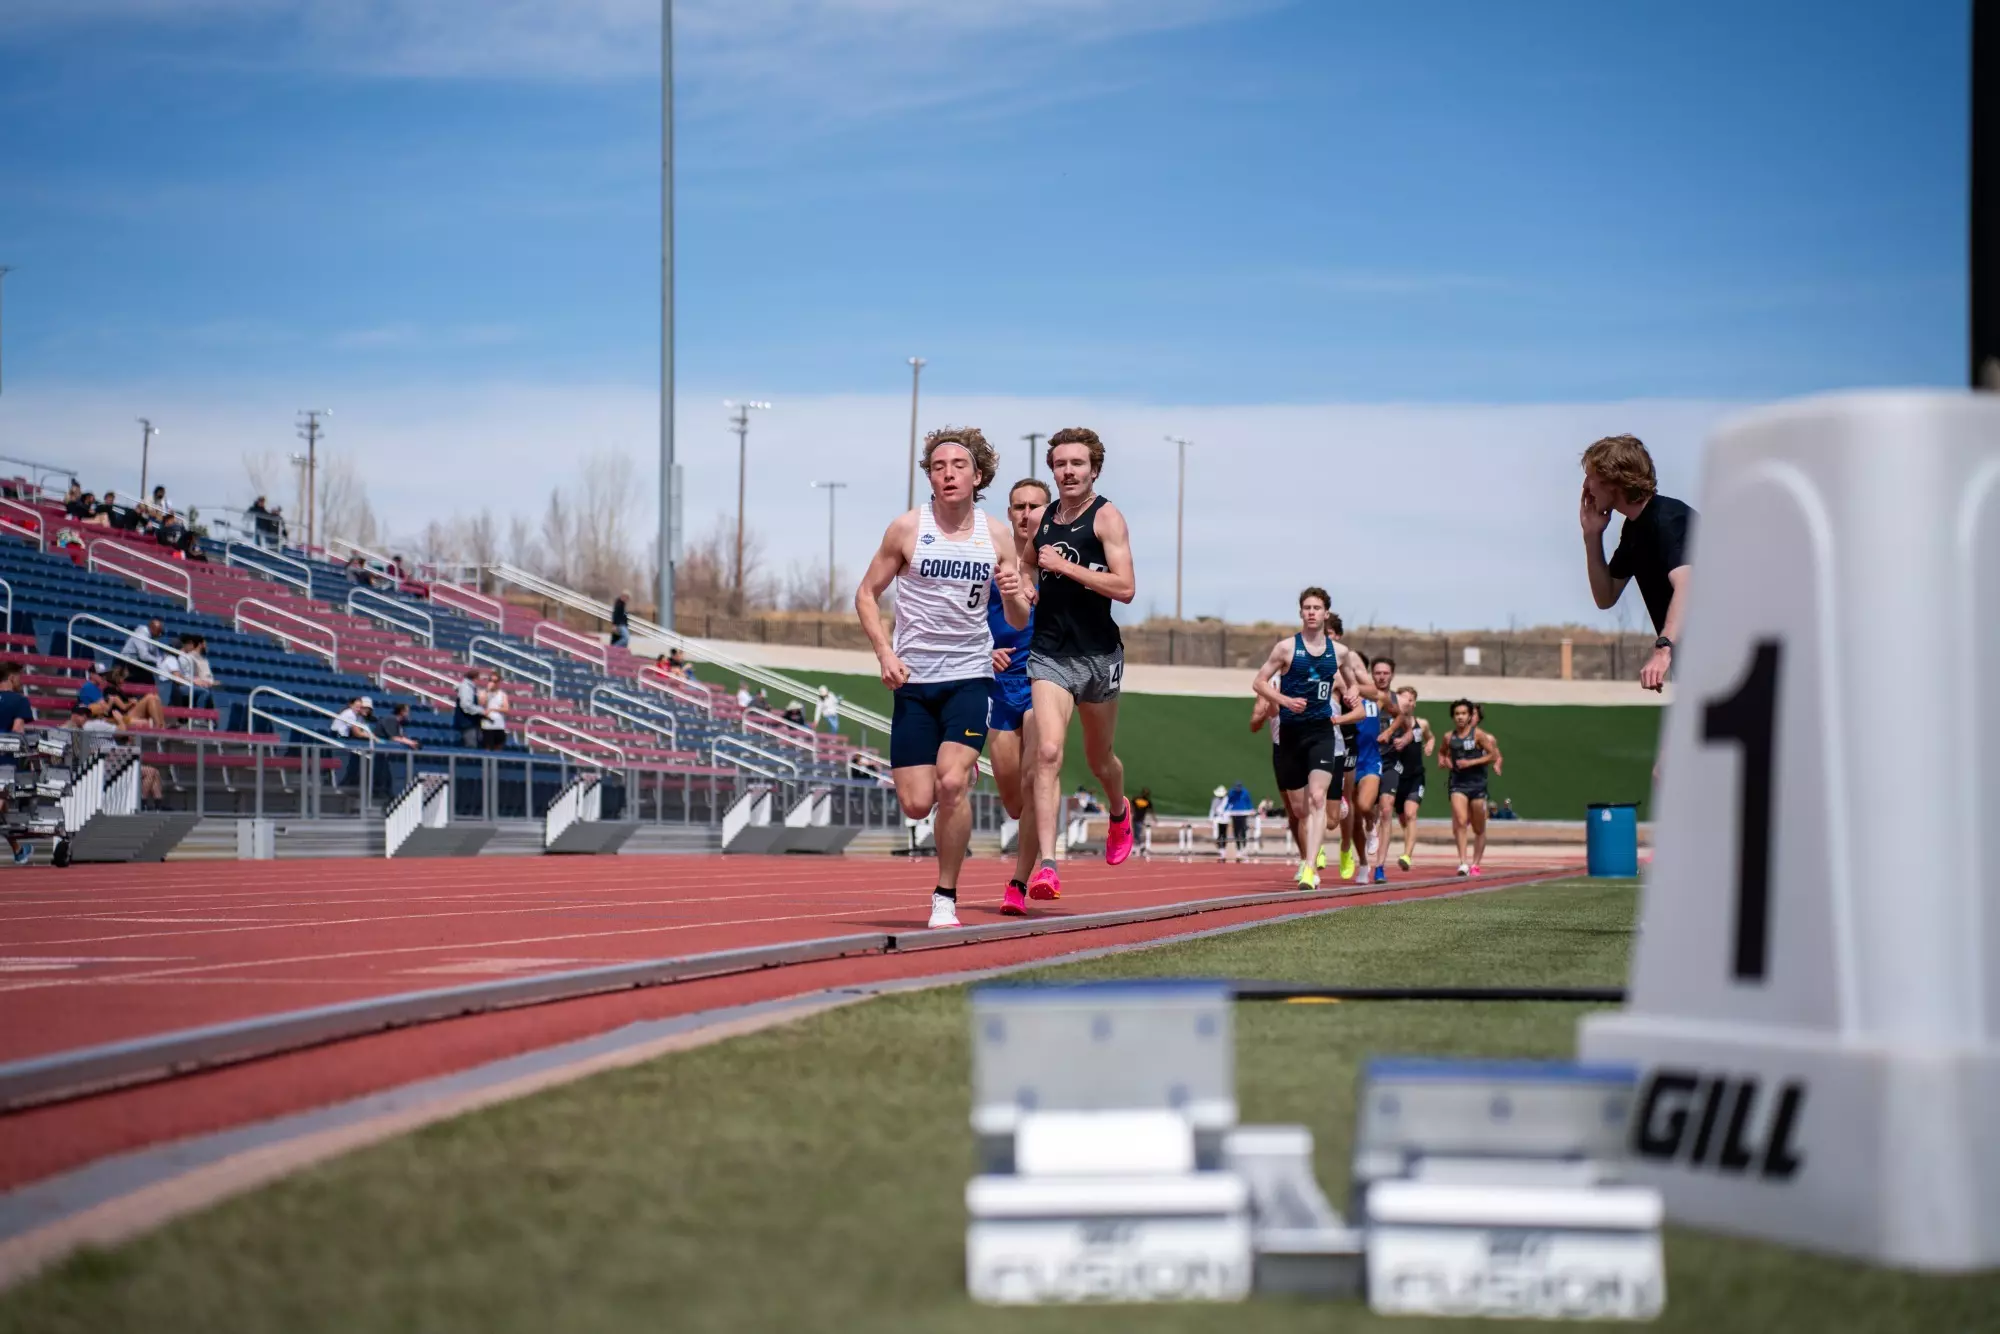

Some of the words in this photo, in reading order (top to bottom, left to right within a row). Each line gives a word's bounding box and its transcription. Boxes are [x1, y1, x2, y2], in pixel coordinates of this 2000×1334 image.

[920, 559, 990, 581] COUGARS
[967, 584, 983, 608] 5
[1111, 663, 1121, 685] 4
[1320, 683, 1328, 699] 8
[1702, 640, 1782, 980] 1
[1634, 1071, 1806, 1178] GILL
